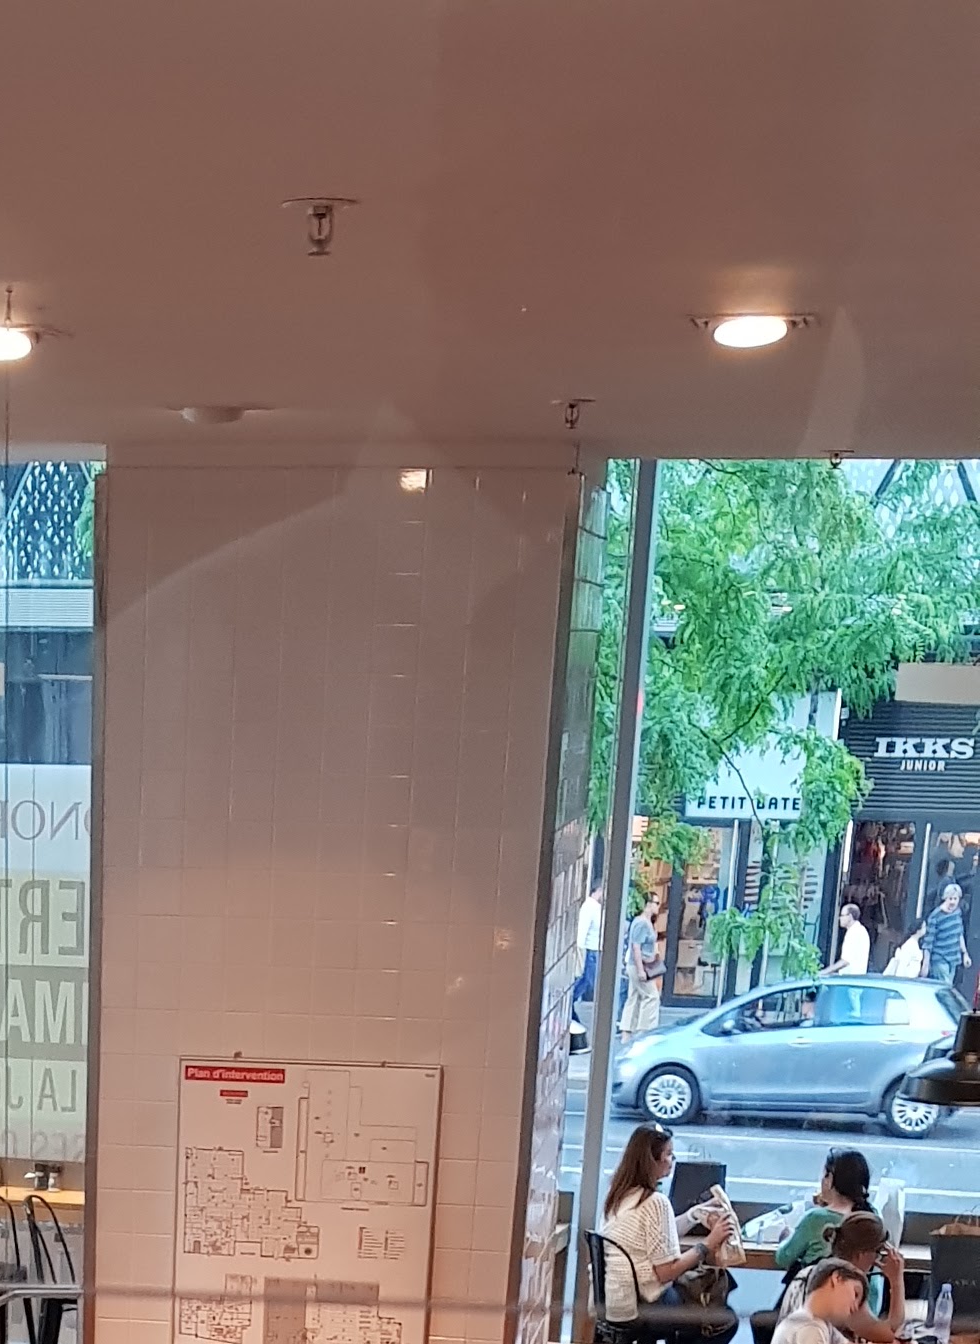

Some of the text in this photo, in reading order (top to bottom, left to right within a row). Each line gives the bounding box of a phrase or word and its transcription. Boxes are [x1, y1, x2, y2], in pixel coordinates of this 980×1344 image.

[874, 736, 975, 760] IKKS
[900, 760, 946, 772] JUNIOR
[697, 795, 801, 811] PETIT BATE
[187, 1067, 284, 1082] Plan d'intervention
